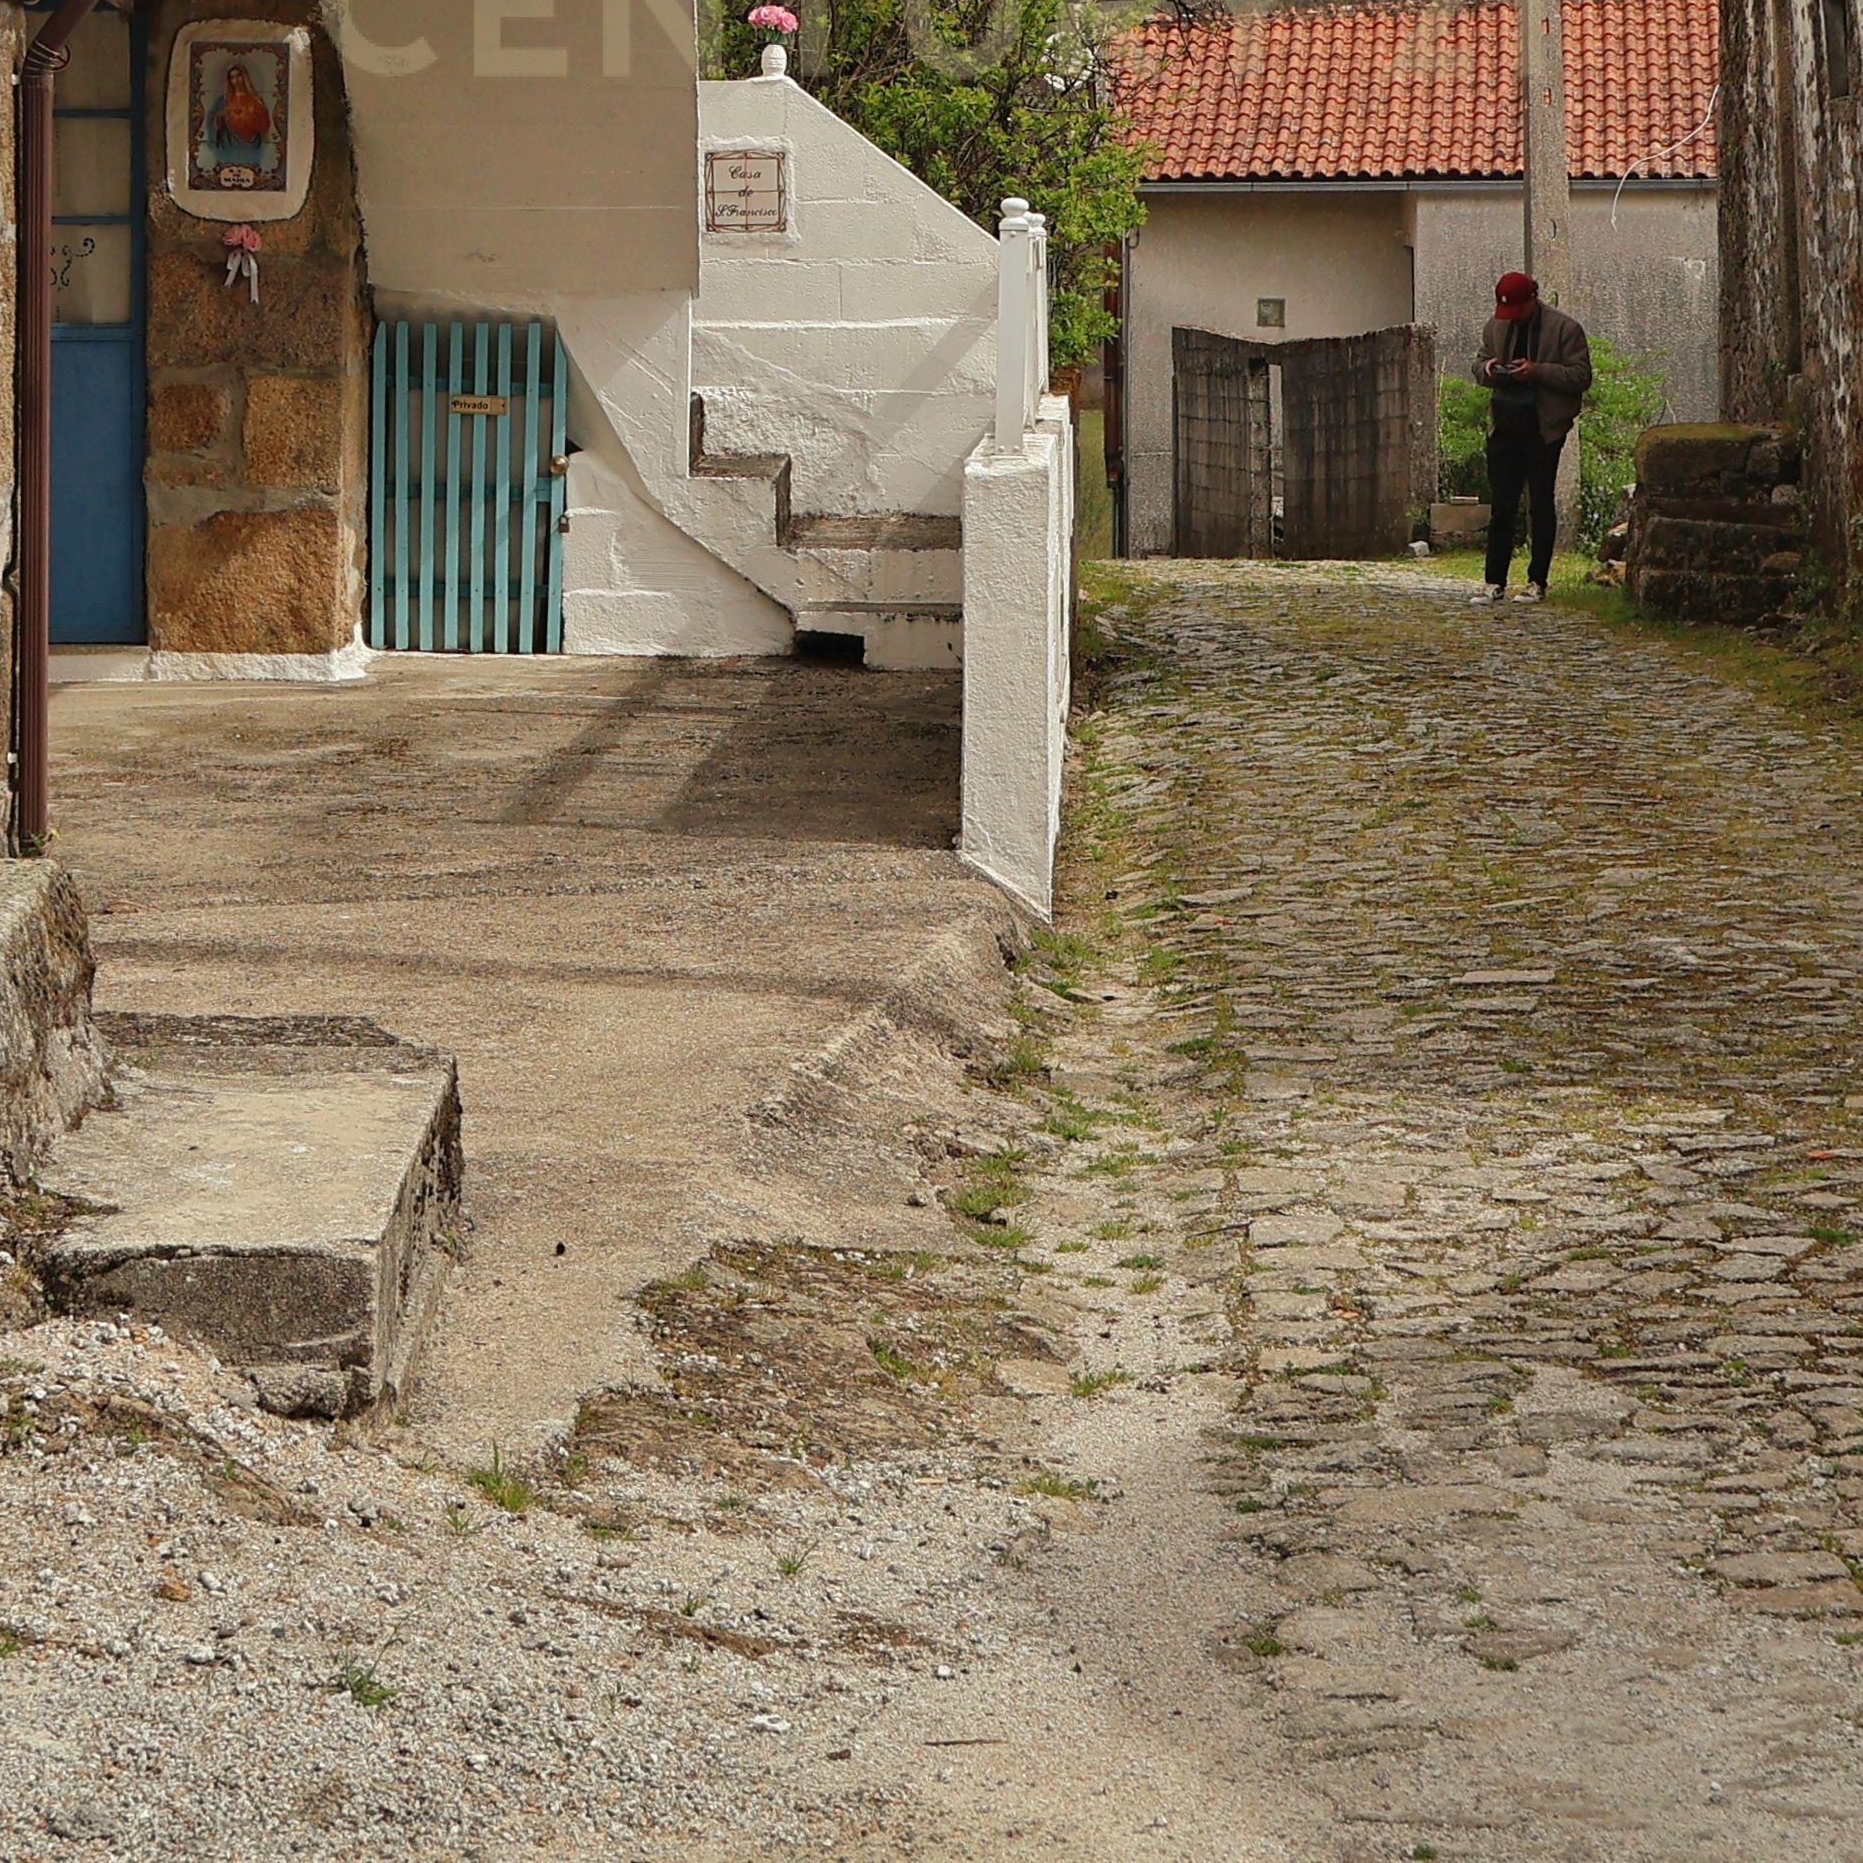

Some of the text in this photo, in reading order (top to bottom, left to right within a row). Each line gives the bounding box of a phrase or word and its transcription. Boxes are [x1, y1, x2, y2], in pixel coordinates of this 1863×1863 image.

[728, 165, 762, 179] Casa
[737, 185, 754, 197] de
[453, 400, 489, 410] Privado
